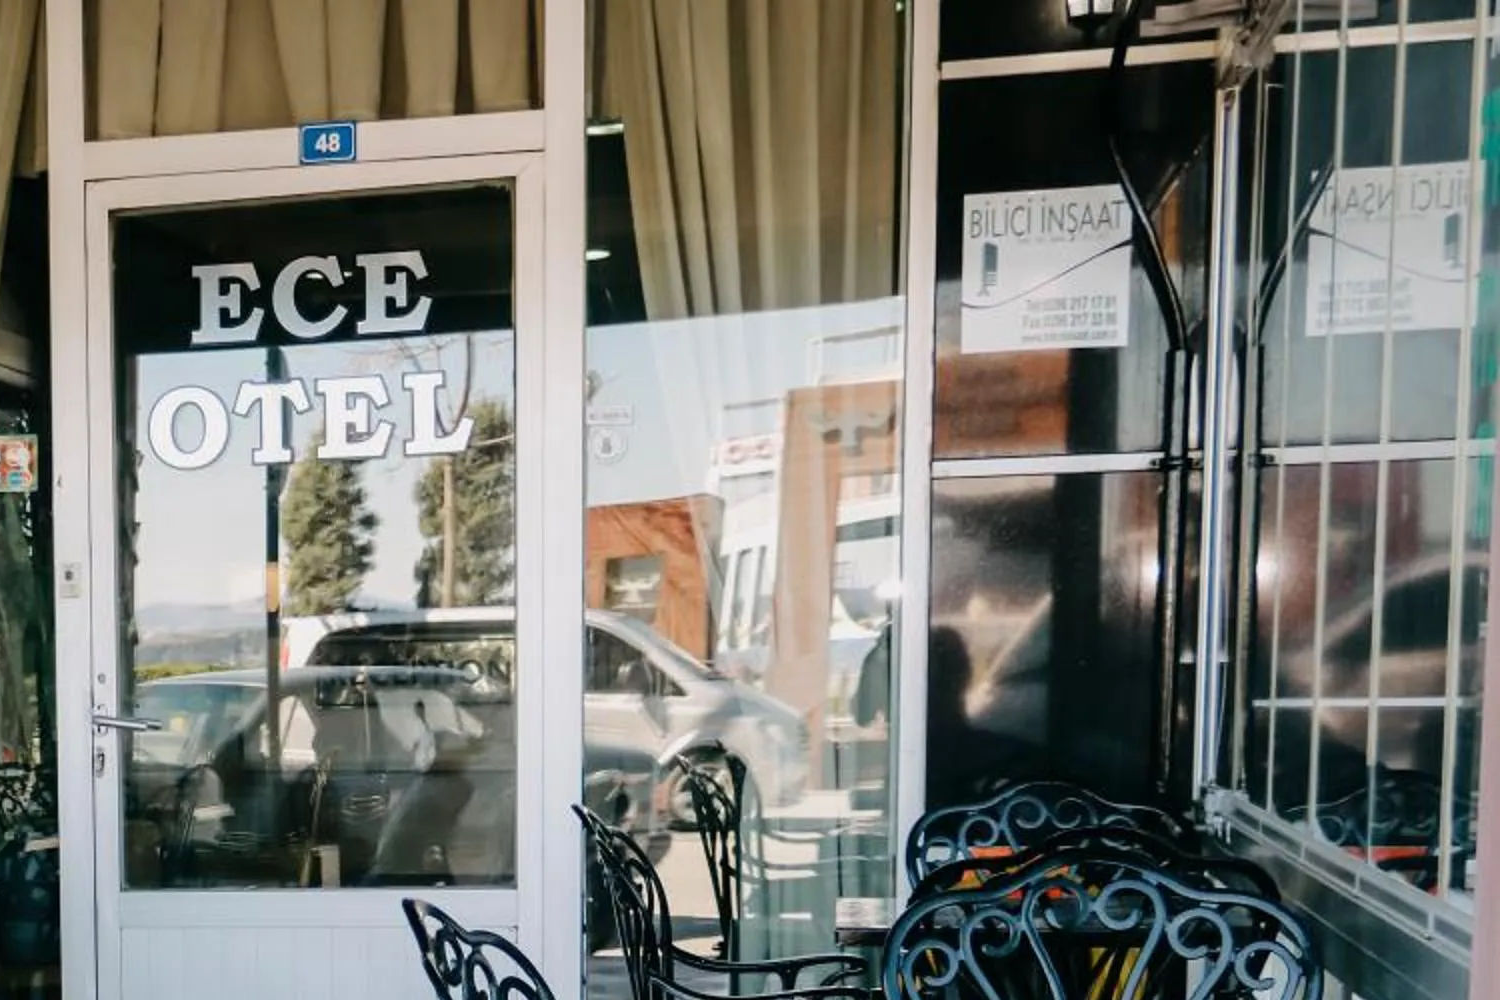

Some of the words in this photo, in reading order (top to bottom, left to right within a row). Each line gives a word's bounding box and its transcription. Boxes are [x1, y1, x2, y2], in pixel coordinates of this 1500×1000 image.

[315, 132, 341, 153] 48
[969, 197, 1032, 239] BİLİCİ
[1040, 196, 1125, 242] İNŞAAT
[190, 249, 433, 346] ECE
[148, 369, 475, 471] OTEL
